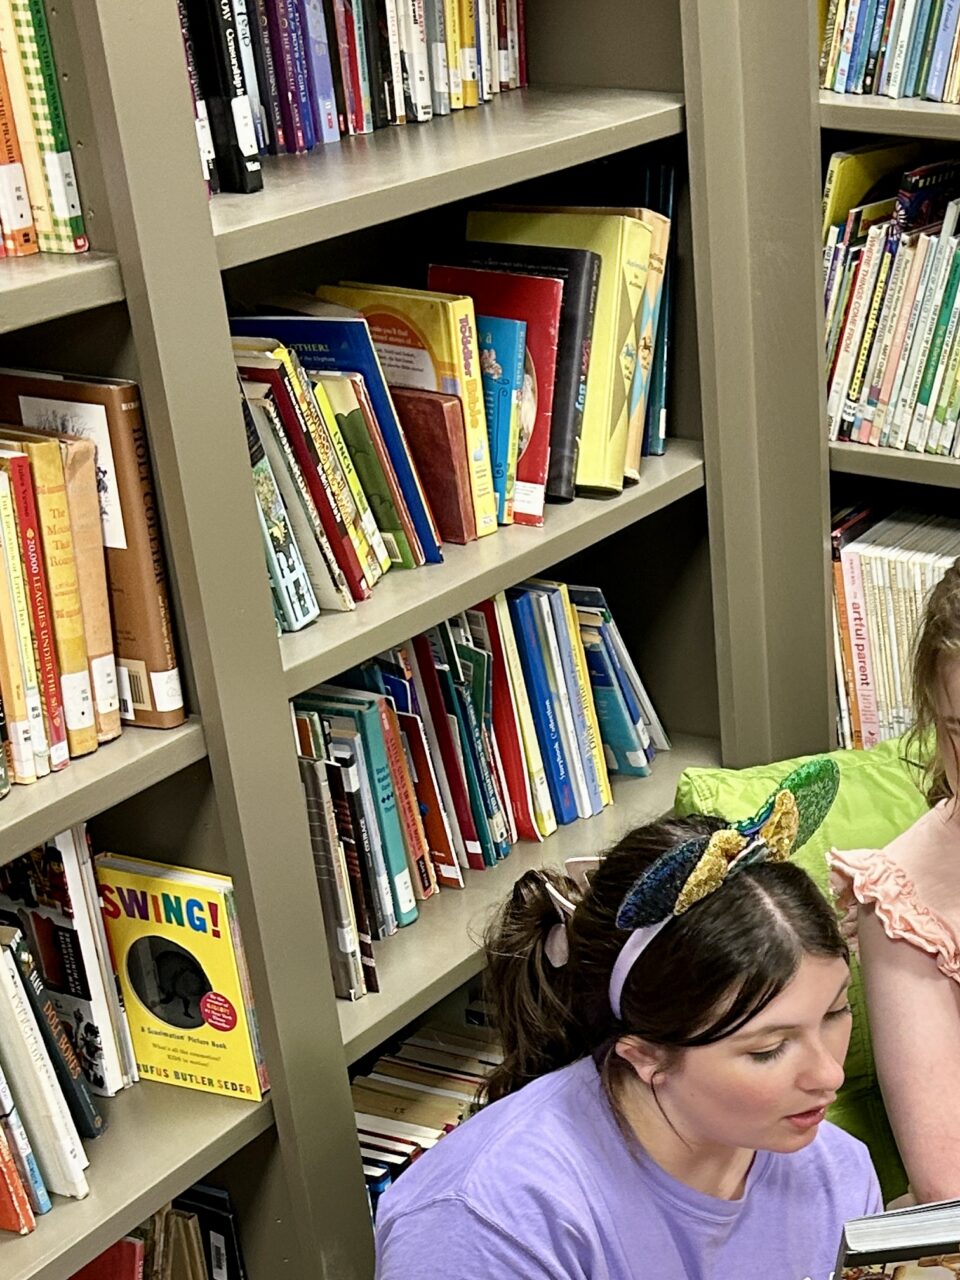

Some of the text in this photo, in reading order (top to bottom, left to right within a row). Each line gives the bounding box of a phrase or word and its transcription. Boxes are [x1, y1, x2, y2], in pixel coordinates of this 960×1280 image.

[843, 236, 876, 353] WHERE THINGS COME FROM
[466, 378, 480, 429] Bible
[333, 431, 353, 474] LYNCH
[132, 427, 164, 584] HOLT COLLIER
[25, 537, 40, 574] 20,000
[31, 575, 47, 629] LEAGUES
[40, 630, 53, 669] UNDER
[851, 601, 870, 686] artful parent
[46, 670, 56, 692] THE
[546, 699, 566, 780] Storybook Collection
[100, 883, 221, 939] SWING!
[42, 1000, 82, 1079] DOLL BONES
[187, 1035, 210, 1047] Picture
[211, 1041, 228, 1050] Book
[174, 1069, 215, 1087] BUTLER
[217, 1079, 254, 1096] SEDER
